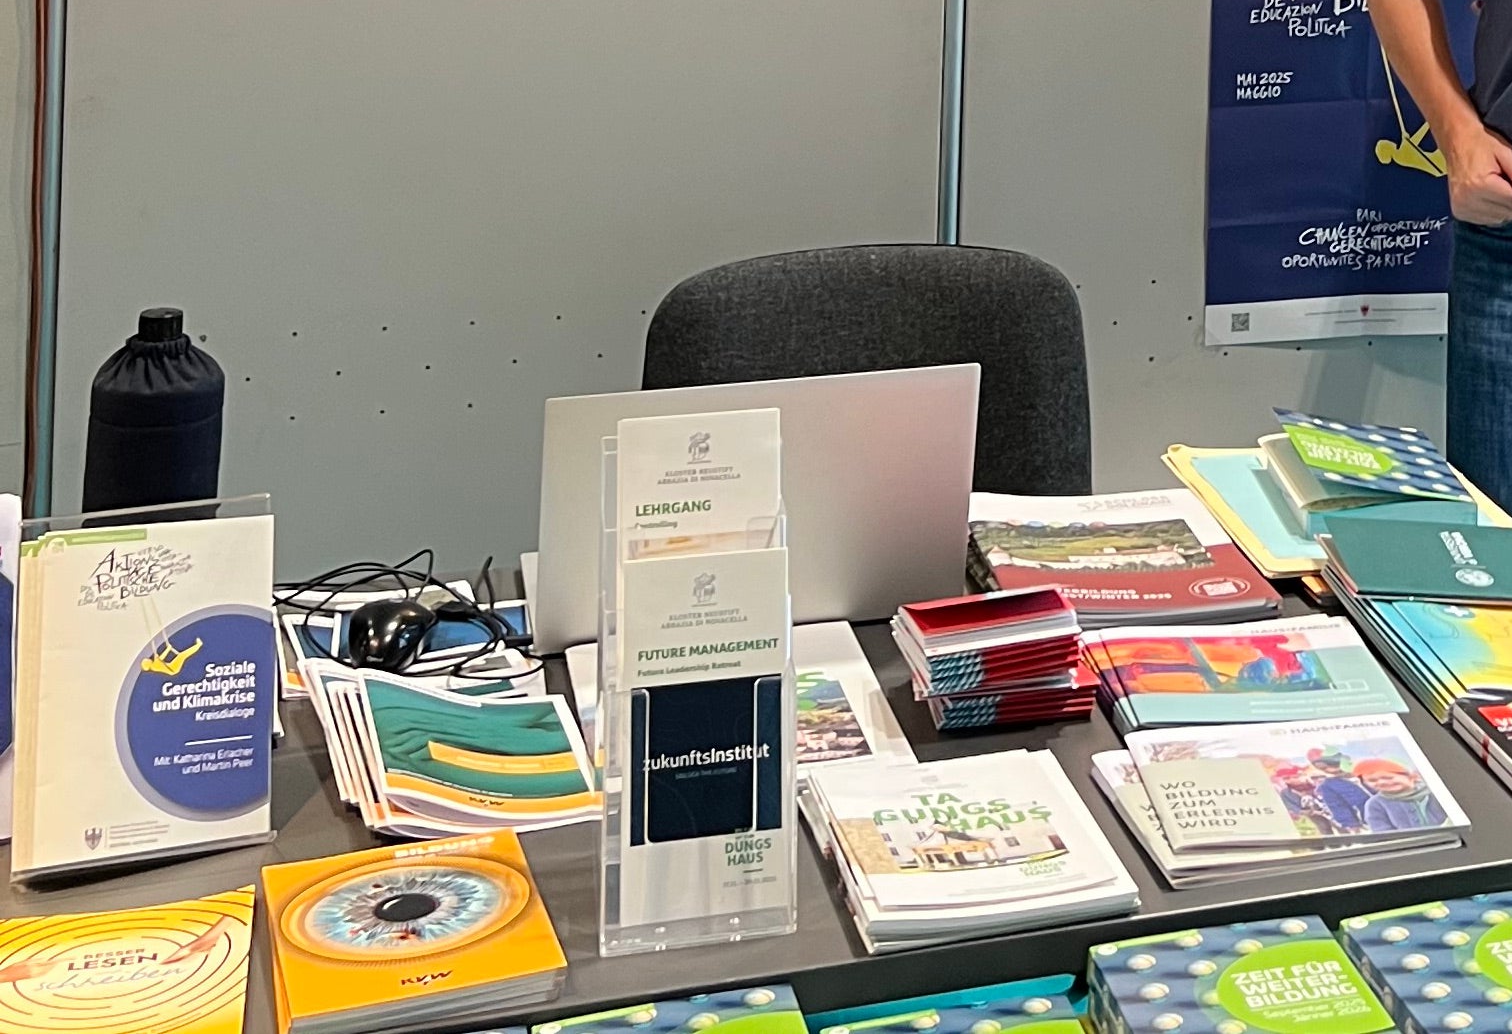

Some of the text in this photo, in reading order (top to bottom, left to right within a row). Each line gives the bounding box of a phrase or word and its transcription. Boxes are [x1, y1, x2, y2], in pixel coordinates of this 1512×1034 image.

[1250, 1, 1323, 24] EDUCAZION
[1288, 17, 1352, 38] POLITICA
[1237, 71, 1293, 86] MAI 2025
[1236, 85, 1282, 100] MAGGIO
[1357, 208, 1382, 222] PARI
[635, 499, 711, 517] LEHRGANG
[638, 638, 779, 662] FUTURE MANAGEMENT
[205, 661, 256, 678] Soziale
[162, 675, 256, 697] Gerechtigkeit
[153, 690, 256, 712] und Klimakrise
[1160, 780, 1196, 790] WO
[1165, 787, 1260, 800] BILDUNG
[911, 792, 962, 807] TA
[1169, 798, 1217, 810] ZUM
[873, 798, 1011, 824] GUNGS
[1174, 806, 1275, 820] ERLEBNIS
[1178, 818, 1237, 829] WIRD
[727, 851, 764, 867] HAUS
[67, 952, 158, 971] LESEN
[1230, 960, 1343, 985] ZEIT FÜR
[1239, 973, 1349, 996] WEITER-
[1245, 982, 1358, 1009] BILDUNG
